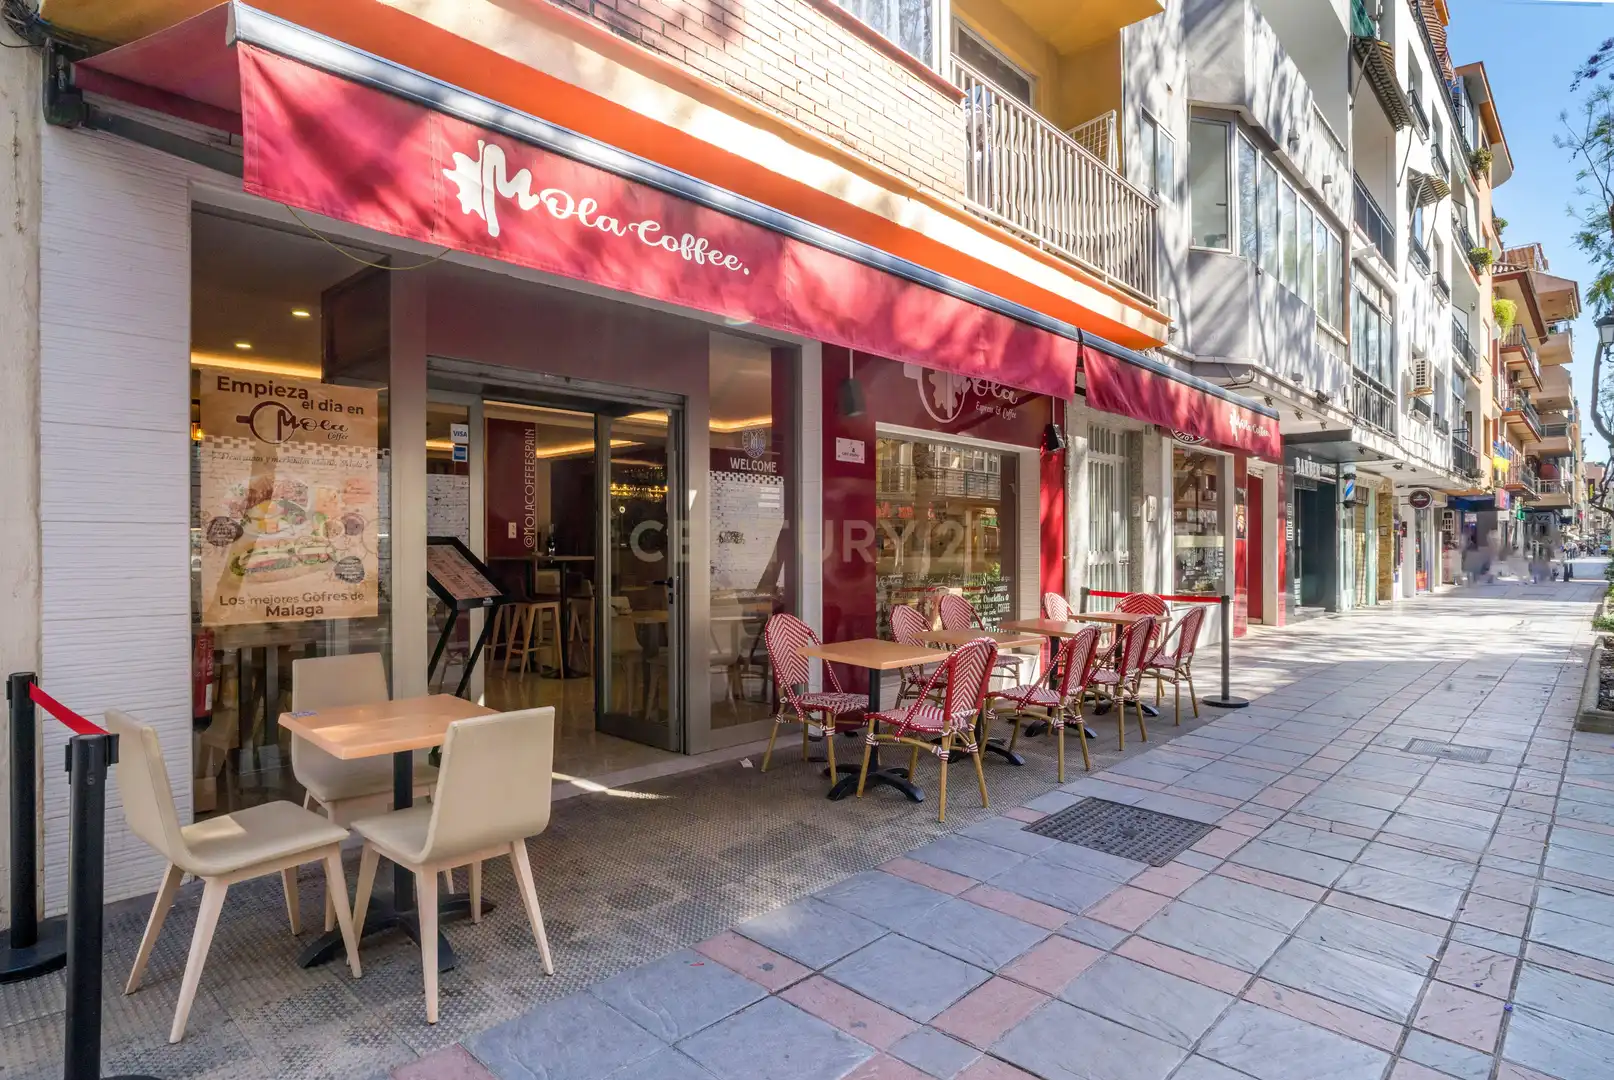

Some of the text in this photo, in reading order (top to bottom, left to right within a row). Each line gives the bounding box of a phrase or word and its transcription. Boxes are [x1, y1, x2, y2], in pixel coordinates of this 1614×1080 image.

[217, 375, 309, 400] Empieza
[302, 398, 365, 415] el dia en
[1002, 407, 1017, 421] Coffee
[327, 430, 349, 441] Coffee
[453, 430, 468, 438] VISA
[729, 456, 778, 473] WELCOME
[524, 428, 536, 548] @MOLACOFFEESPAIN
[219, 595, 245, 606] Los
[350, 591, 365, 601] de
[266, 604, 324, 618] Malaga
